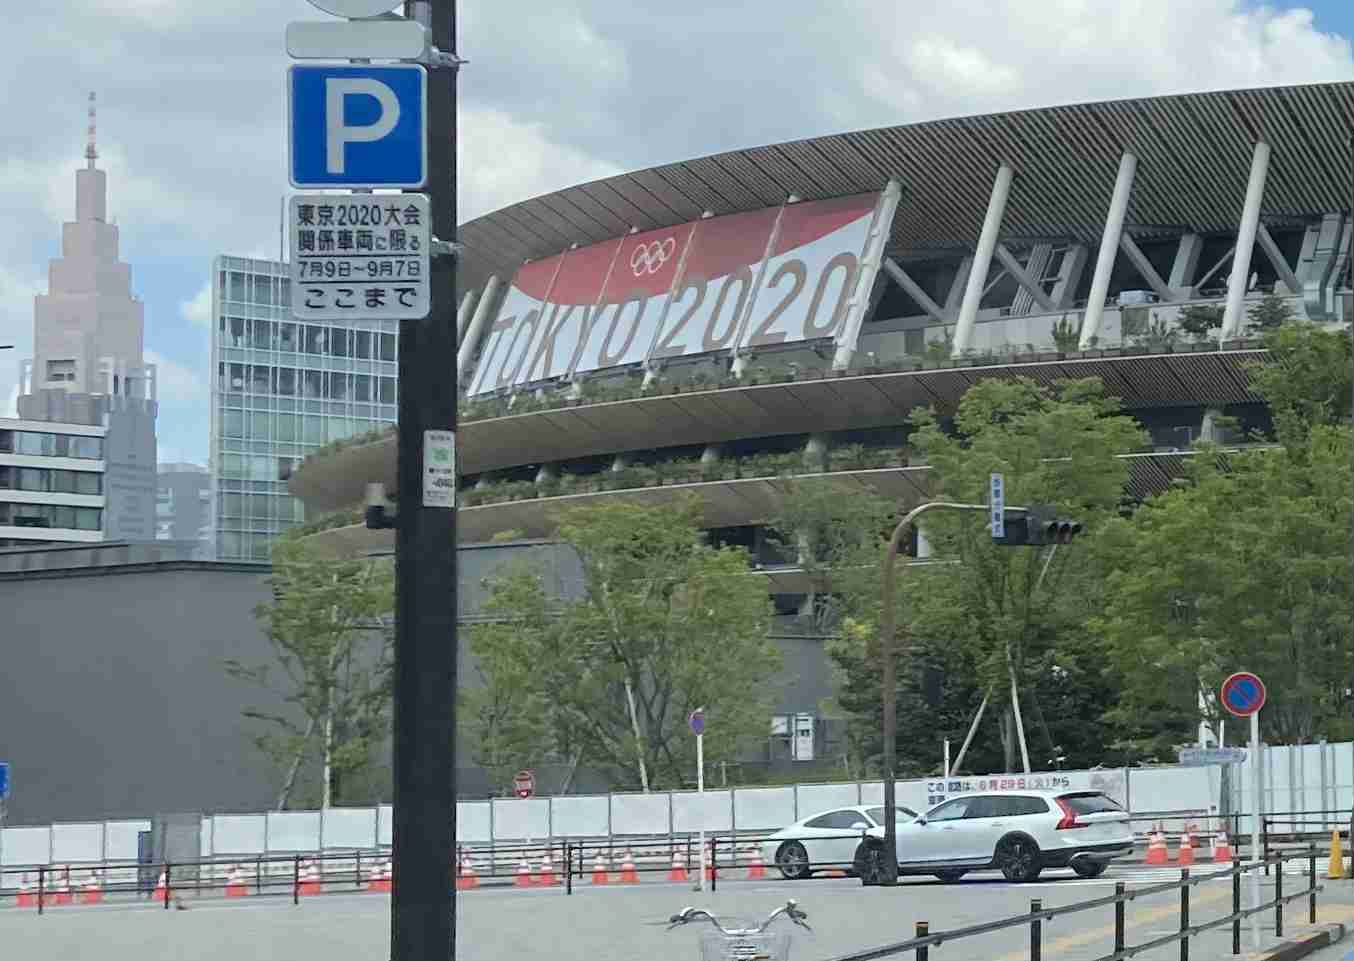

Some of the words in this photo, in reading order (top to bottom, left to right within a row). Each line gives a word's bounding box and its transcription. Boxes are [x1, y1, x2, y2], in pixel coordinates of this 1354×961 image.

[325, 77, 401, 174] P
[297, 204, 420, 226] 東京2020大会
[297, 229, 420, 251] 関係車両に限る
[304, 287, 417, 309] ここまで
[474, 290, 648, 392] TOKYO
[658, 252, 859, 356] 2020
